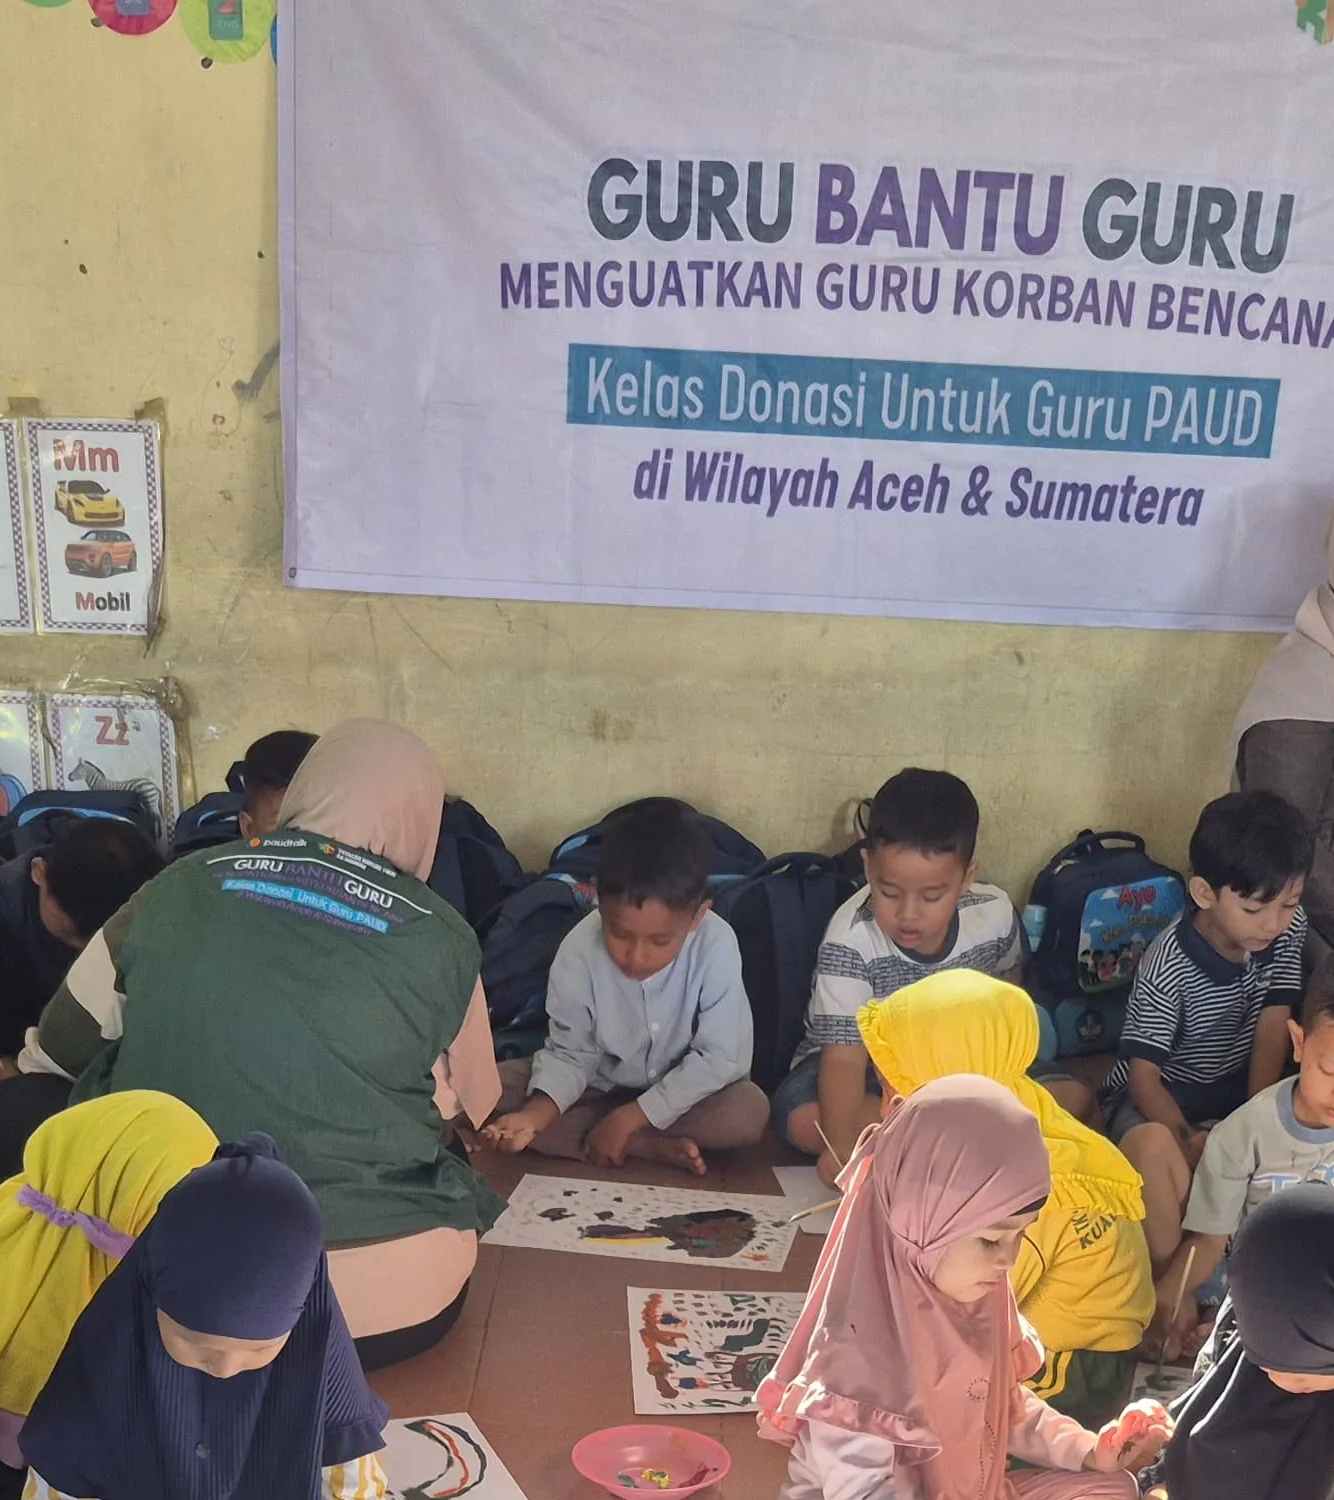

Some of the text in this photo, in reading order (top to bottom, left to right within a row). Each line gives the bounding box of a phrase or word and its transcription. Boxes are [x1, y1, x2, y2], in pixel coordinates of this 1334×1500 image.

[586, 157, 1295, 274] GURU BANTU GURU
[500, 261, 803, 310] MENGUATKAN
[816, 263, 941, 315] GURU
[953, 269, 1134, 328] KORBAN
[587, 357, 1265, 448] Kelas Donasi Untuk Guru PAUD
[53, 439, 120, 473] Mm
[633, 449, 1205, 527] di Wilayah Aceh & Sumatera
[75, 591, 131, 612] Mobil
[95, 715, 130, 746] Zz
[234, 859, 284, 873] GURU
[344, 879, 393, 909] GURU
[1119, 884, 1157, 911] Ayo
